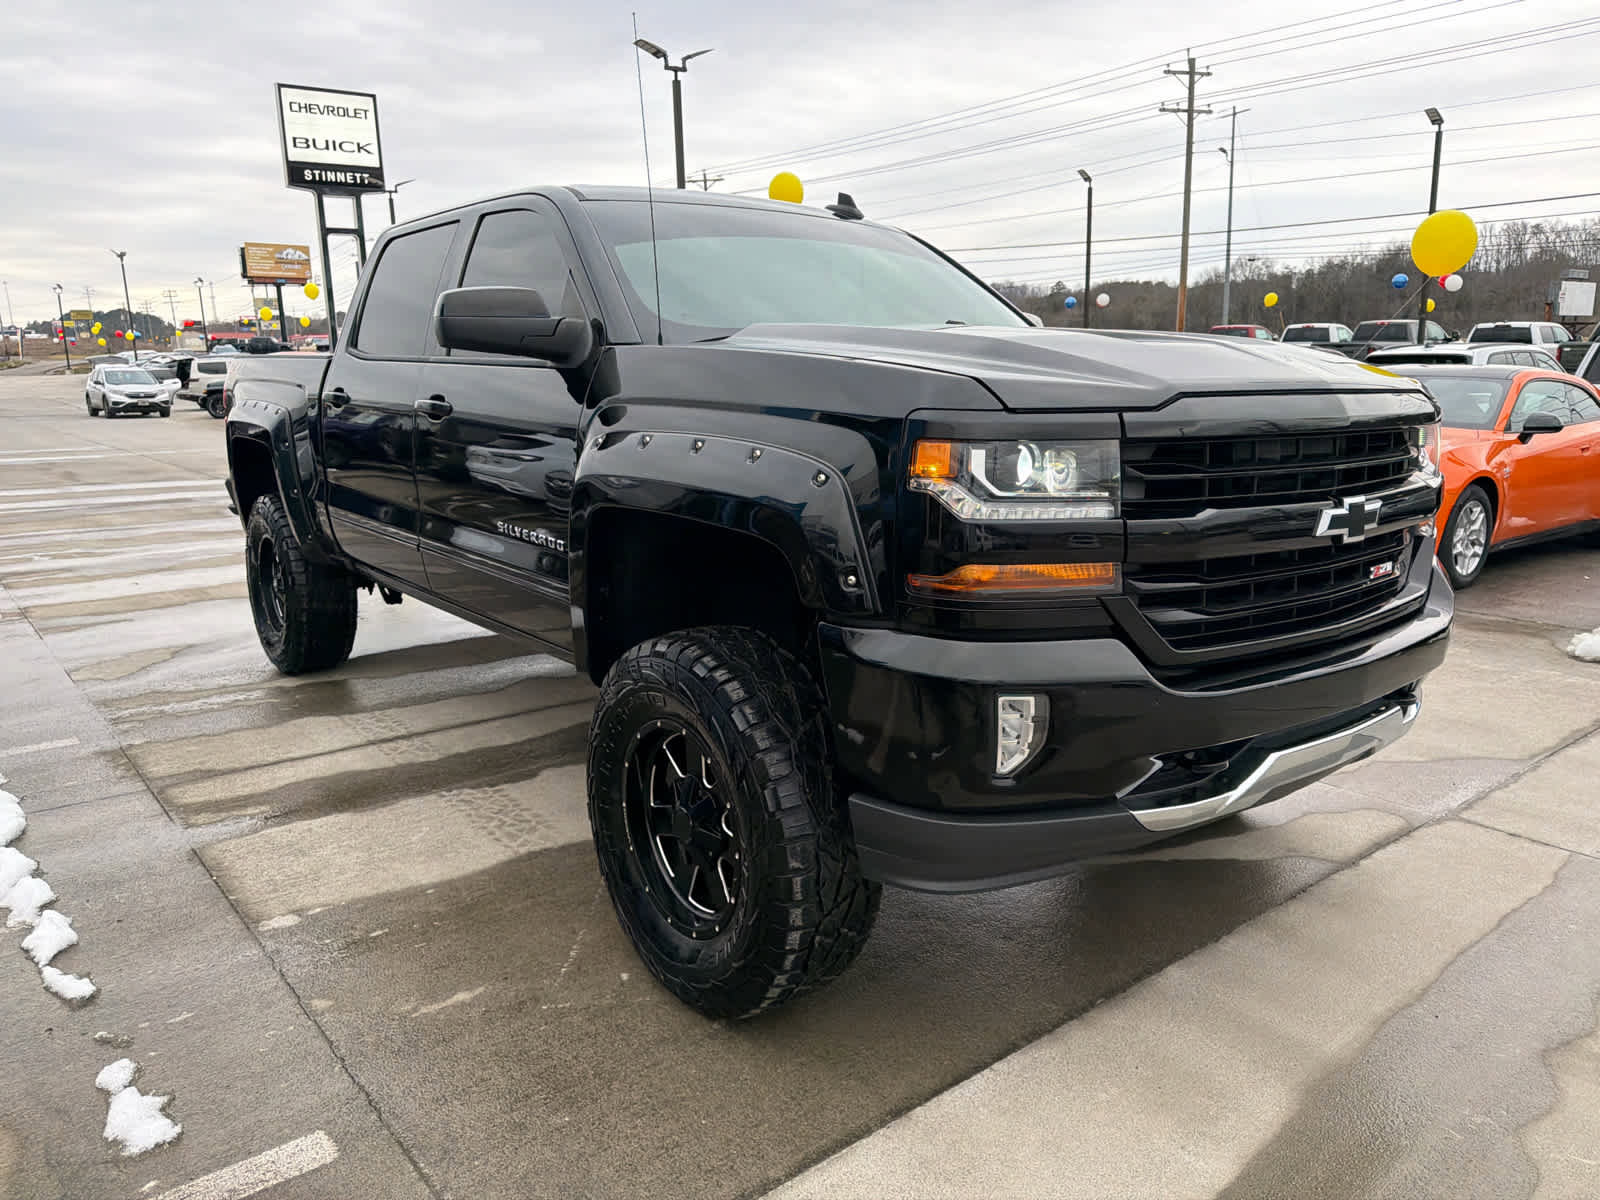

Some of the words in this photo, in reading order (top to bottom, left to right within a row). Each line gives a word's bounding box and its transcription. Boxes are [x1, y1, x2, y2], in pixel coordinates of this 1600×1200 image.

[288, 101, 370, 120] CHEVROLET
[292, 136, 375, 155] BUICK
[303, 169, 370, 184] STINNETT
[496, 520, 565, 552] SILVERADO
